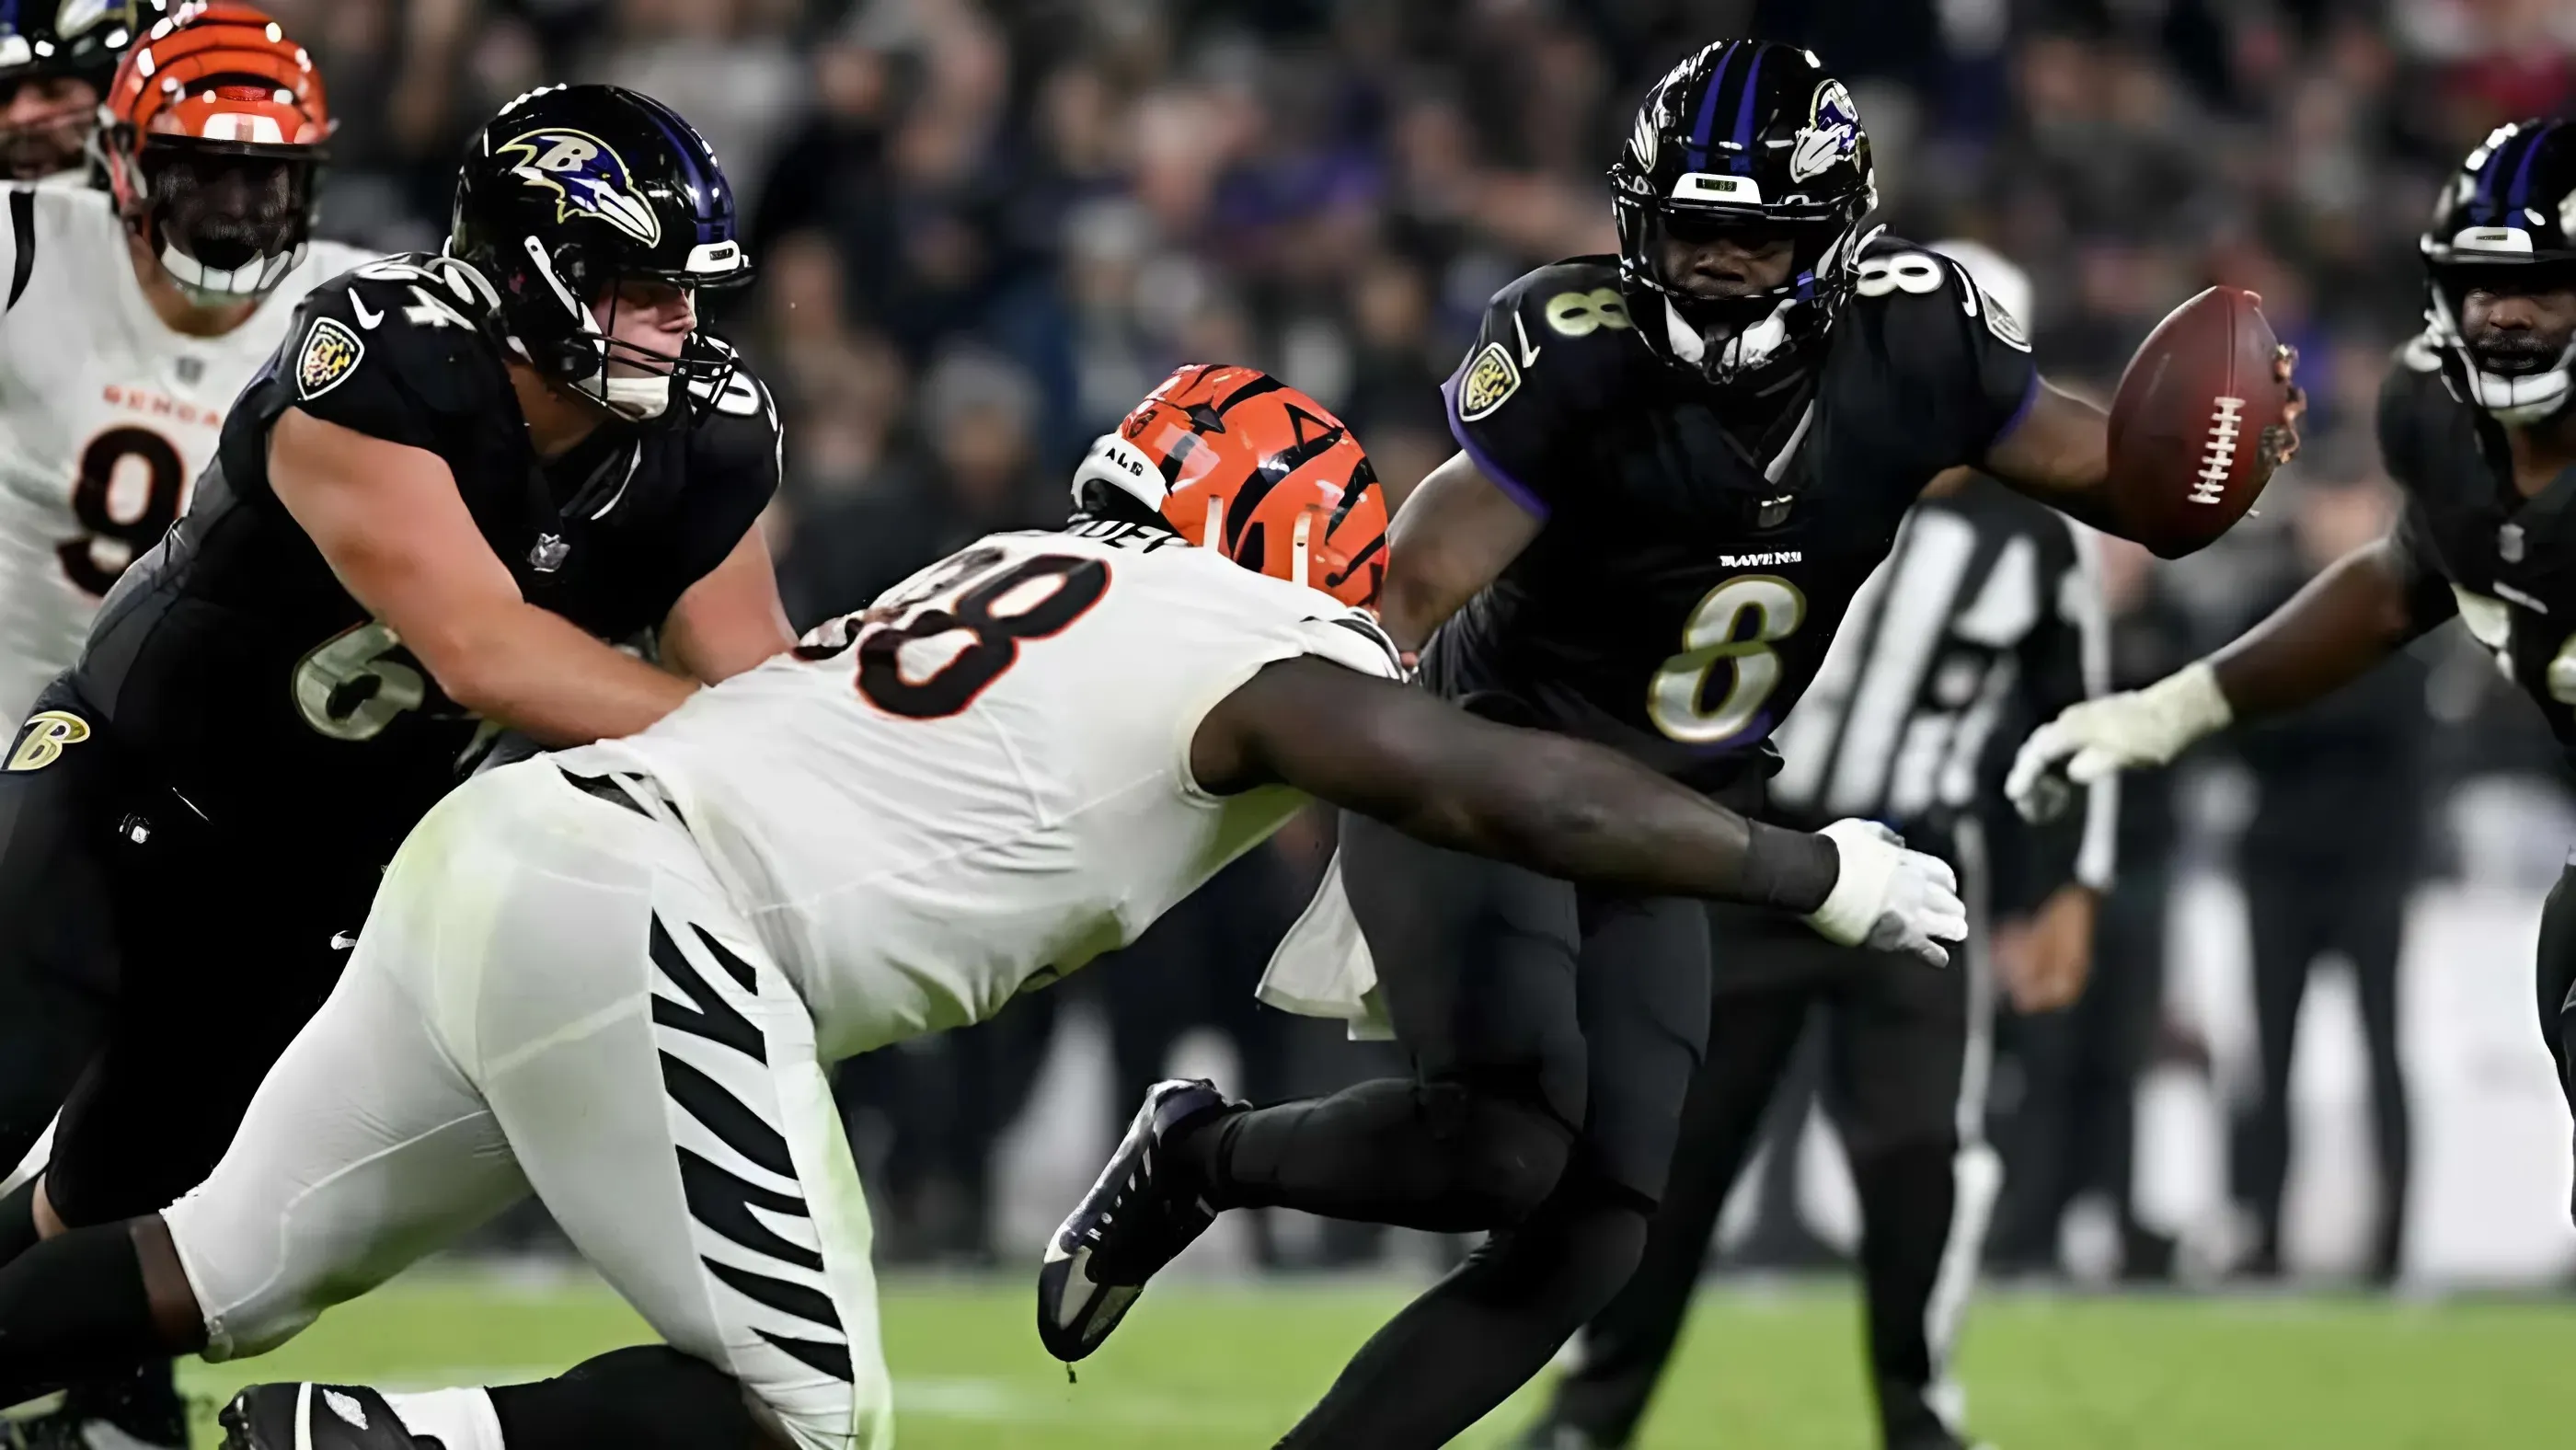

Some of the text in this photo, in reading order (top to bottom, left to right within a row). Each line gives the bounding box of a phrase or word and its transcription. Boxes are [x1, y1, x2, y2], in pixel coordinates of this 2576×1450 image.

[1856, 253, 1947, 299] 8
[1545, 287, 1634, 338] 8
[291, 620, 426, 742] 6
[1647, 573, 1808, 743] 8
[7, 710, 91, 771] B
